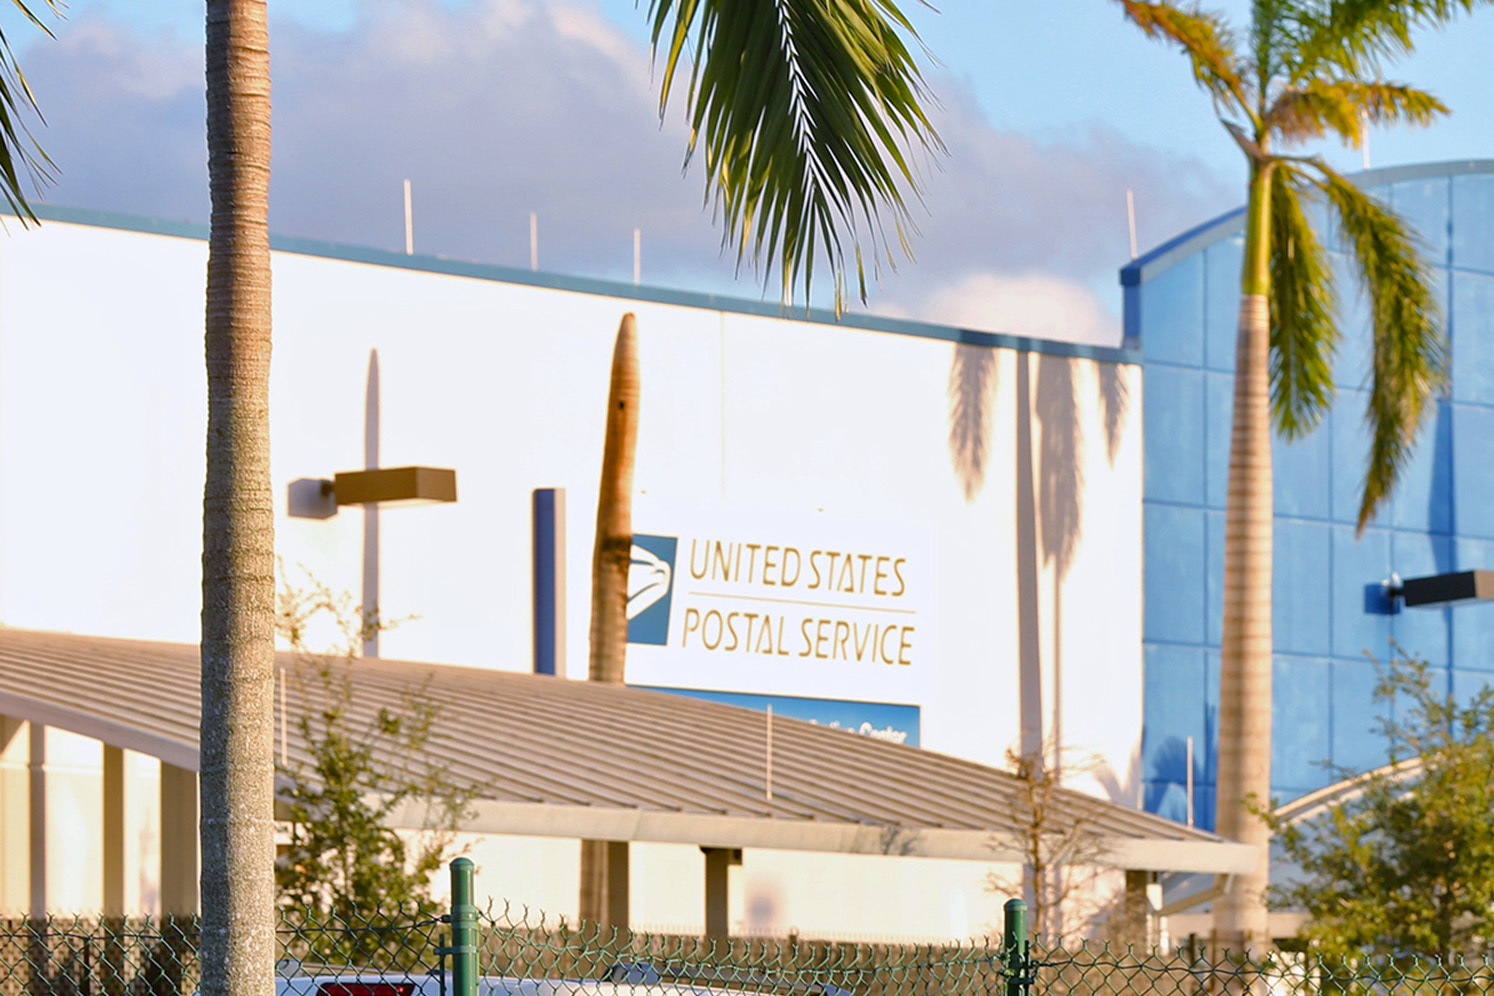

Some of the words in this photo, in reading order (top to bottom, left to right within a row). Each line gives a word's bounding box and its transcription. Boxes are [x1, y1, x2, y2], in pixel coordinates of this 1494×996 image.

[690, 538, 801, 587] UNITED
[807, 550, 906, 597] STATES
[682, 608, 790, 656] POSTAL
[798, 617, 915, 666] SERVICE
